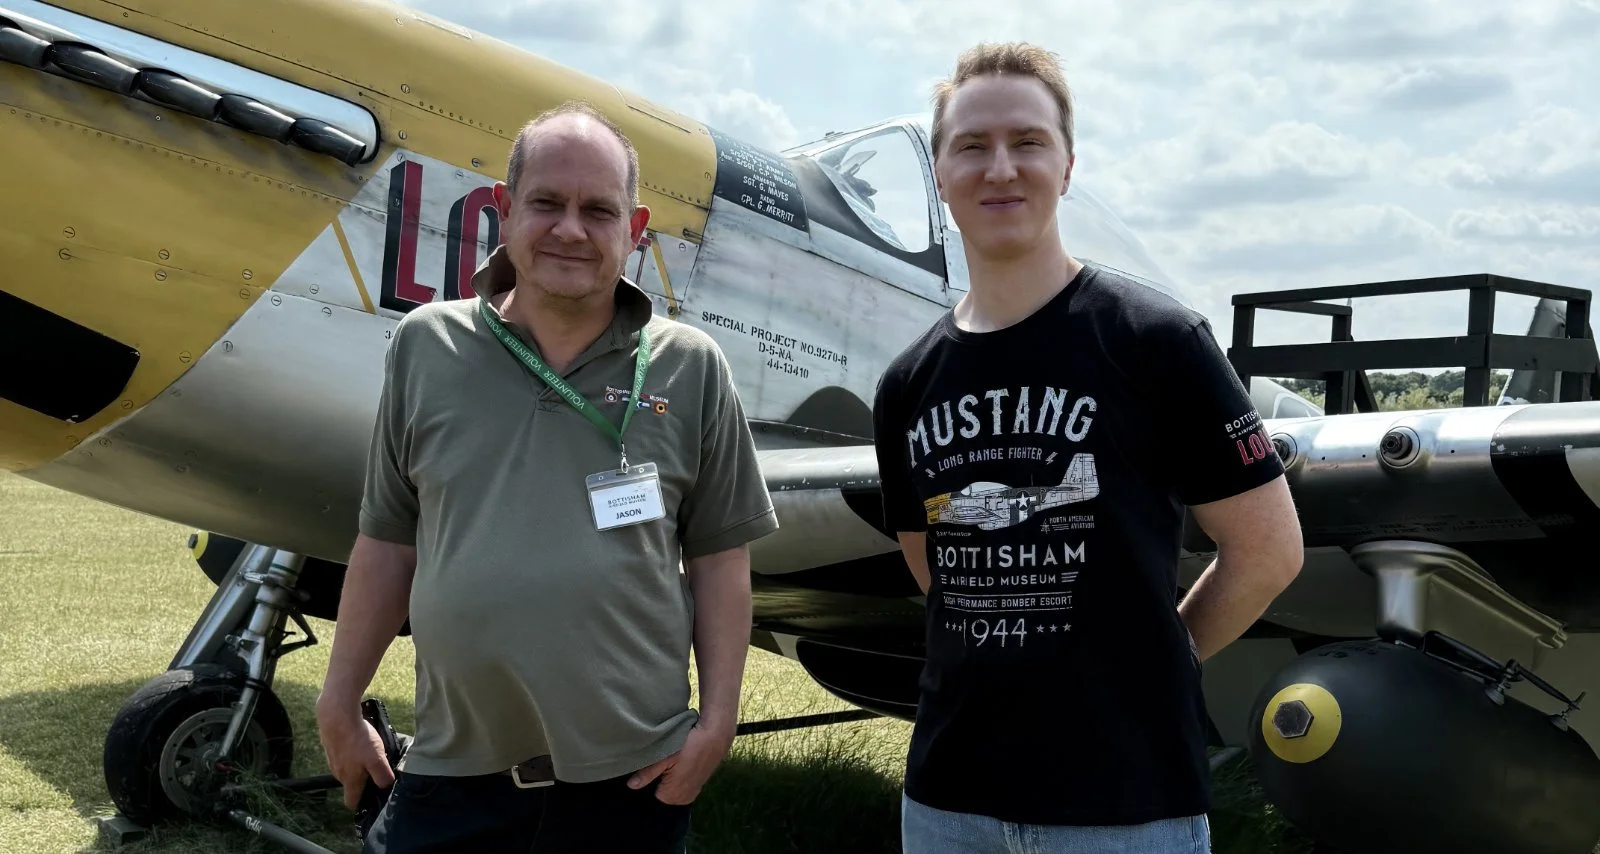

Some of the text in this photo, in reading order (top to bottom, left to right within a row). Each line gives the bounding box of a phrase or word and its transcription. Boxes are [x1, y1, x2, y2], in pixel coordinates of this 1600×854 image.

[743, 175, 789, 202] SGT. G. MAYES
[774, 174, 797, 190] WILSON
[741, 193, 755, 207] CPL.
[766, 205, 794, 222] MERRITT
[380, 159, 504, 316] LO
[702, 311, 746, 334] SPECIAL
[751, 326, 797, 349] PROJECT
[504, 335, 542, 371] VOLUNTEER
[766, 358, 809, 379] 44-13410
[543, 370, 585, 409] VOLUNTEER
[906, 386, 1098, 469] MUSTANG
[938, 446, 1043, 472] LONG RANGE FIGHTER
[607, 493, 646, 505] BOTTISHAM
[615, 508, 642, 520] JASON
[1049, 516, 1067, 524] NORTH
[936, 540, 1086, 569] BOTTISHAM
[1000, 574, 1057, 586] MUSEUM
[1001, 598, 1036, 608] BOMBER
[1040, 595, 1073, 606] ESCORT
[963, 618, 1028, 648] 1944
